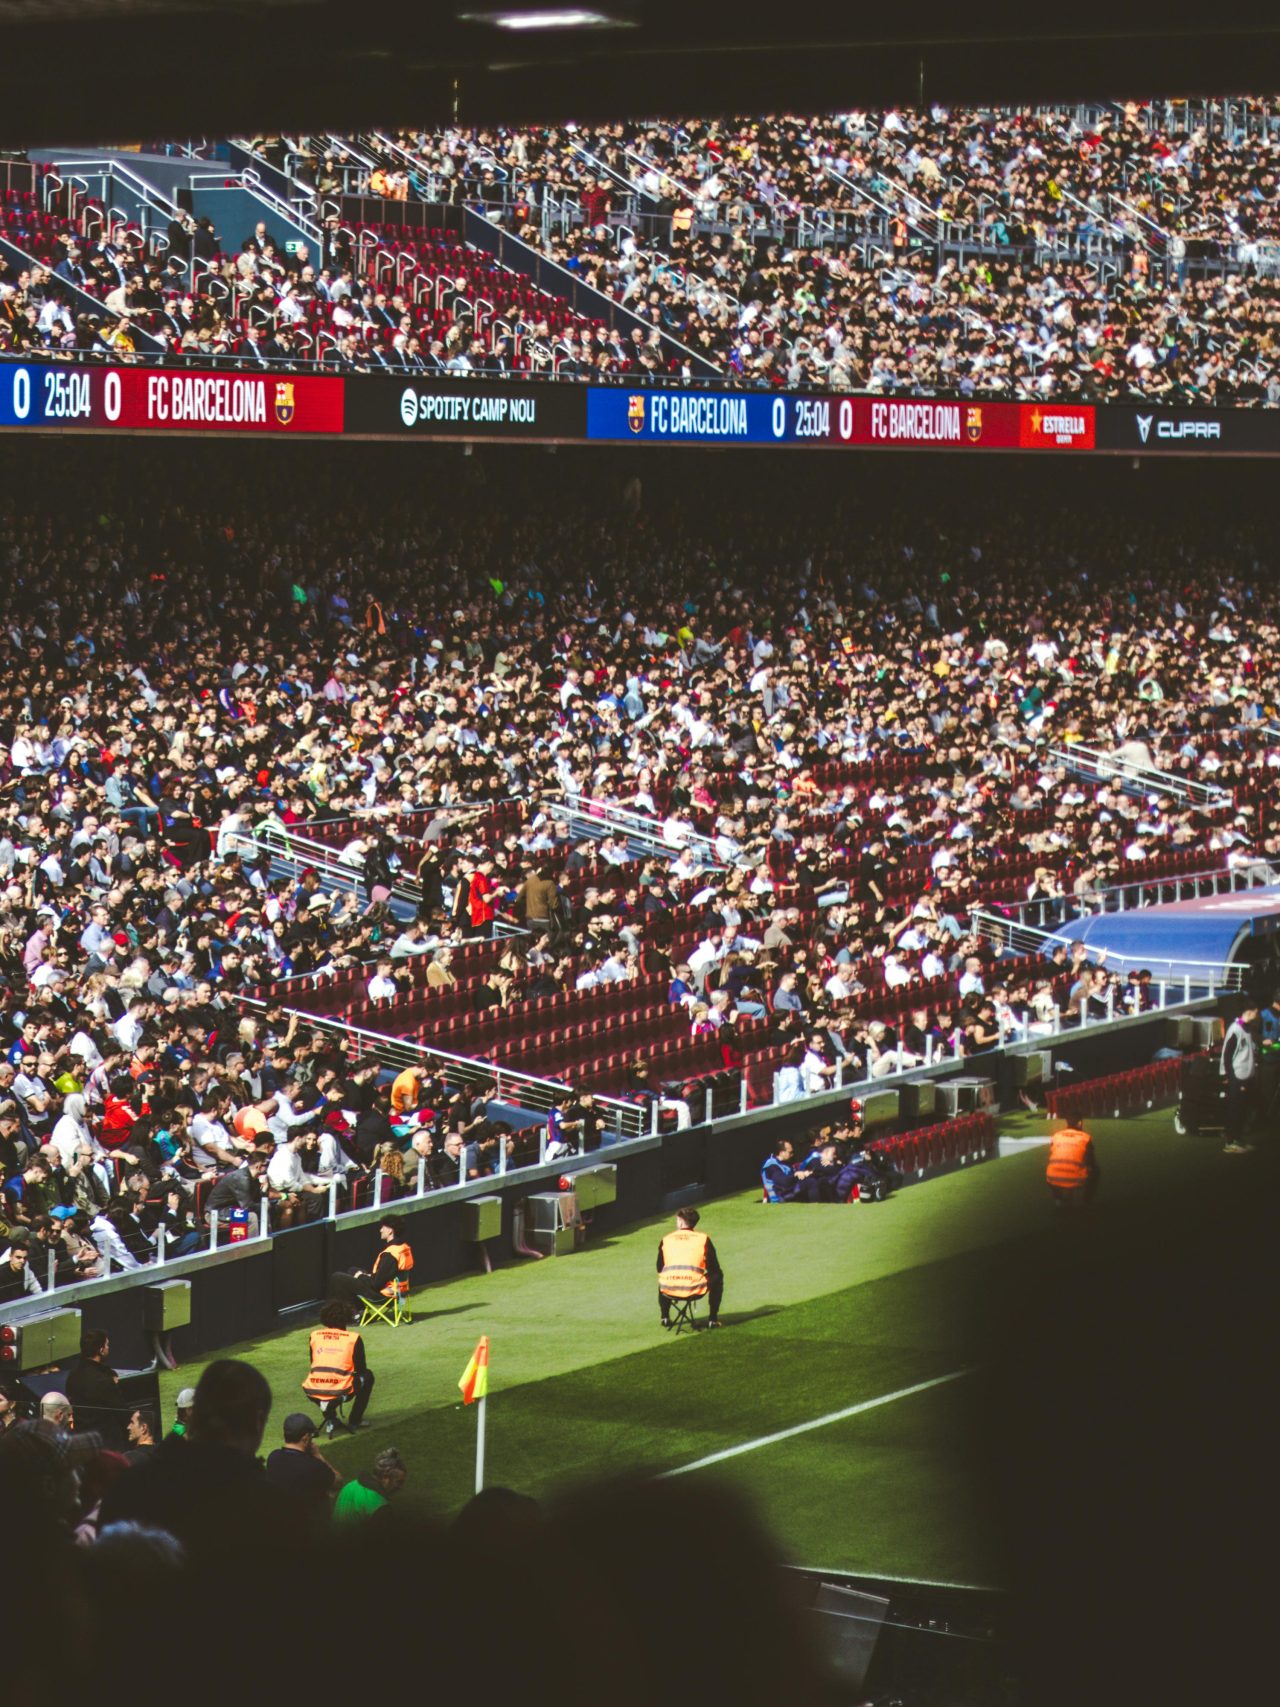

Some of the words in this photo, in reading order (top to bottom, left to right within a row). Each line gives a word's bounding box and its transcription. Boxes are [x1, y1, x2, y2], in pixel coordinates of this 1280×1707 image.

[13, 368, 31, 419] 0
[44, 371, 92, 418] 25:04
[104, 371, 122, 421] 0
[147, 375, 169, 420] FC
[171, 376, 267, 423] BARCELONA
[419, 395, 471, 421] SPOTIFY
[472, 397, 507, 422] CAMP
[509, 398, 535, 423] NOU
[651, 395, 668, 433] FC
[670, 396, 748, 435] BARCELONA
[772, 397, 786, 438] 0
[795, 400, 831, 437] 25:04
[839, 399, 853, 440] 0
[871, 402, 888, 439] FC
[889, 403, 961, 440] BARCELONA
[1043, 415, 1085, 434] ESTRELLA
[1157, 421, 1221, 439] CUPRA
